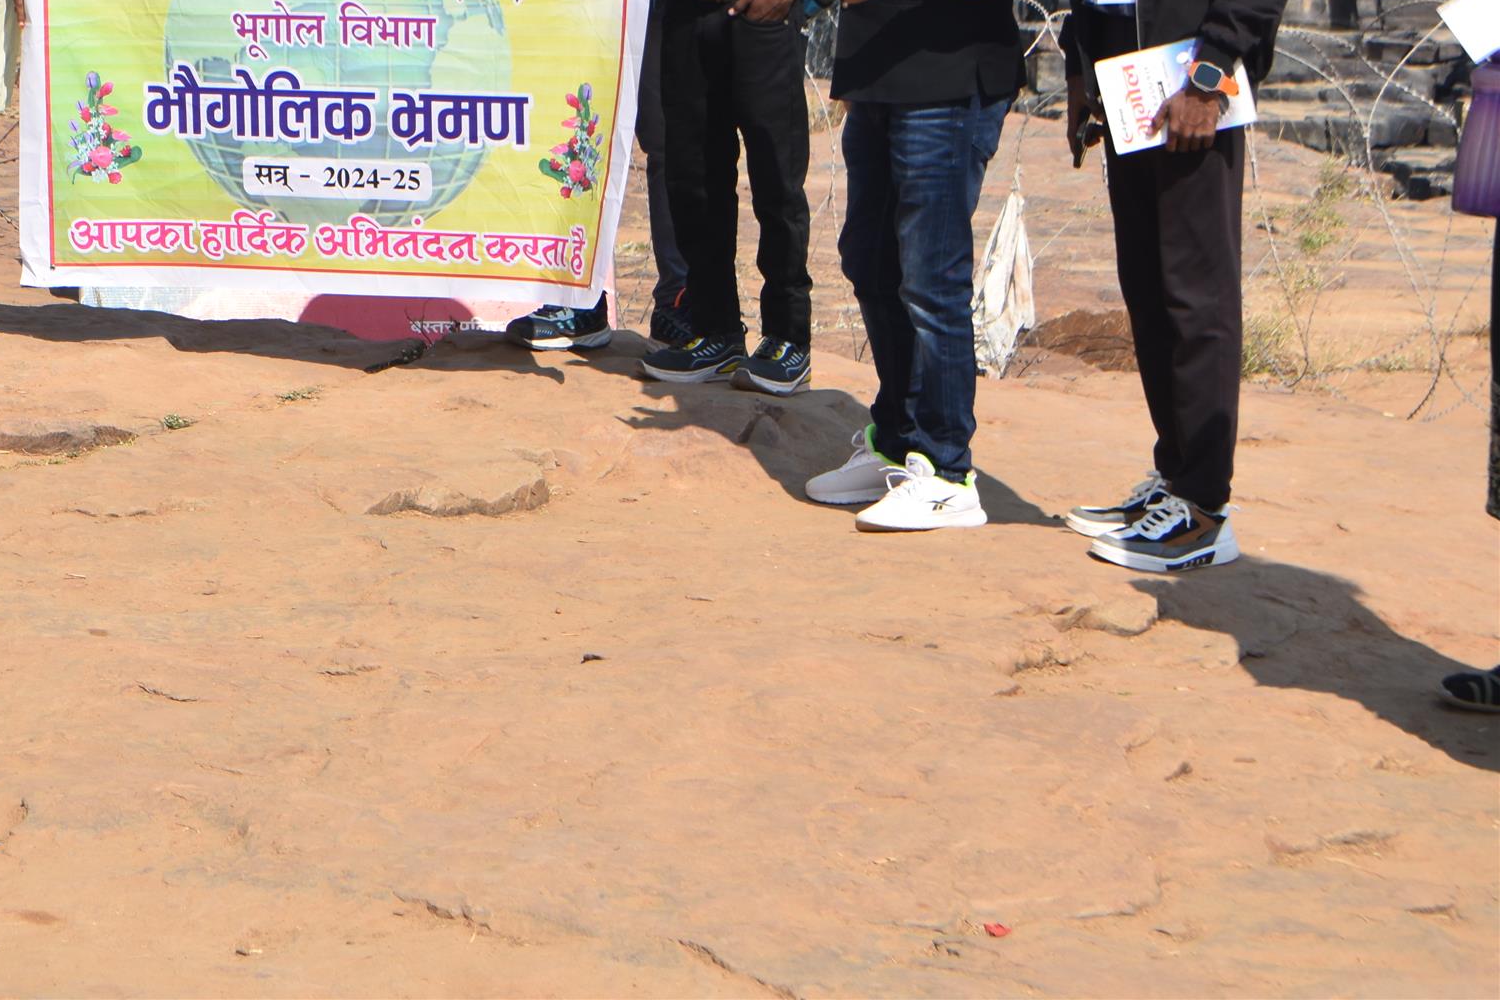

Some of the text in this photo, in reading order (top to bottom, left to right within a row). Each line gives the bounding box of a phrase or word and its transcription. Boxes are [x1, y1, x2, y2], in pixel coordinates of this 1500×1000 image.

[232, 1, 437, 59] भूगोल विभाग
[146, 64, 529, 147] भौगोलिक भ्रमण
[322, 166, 421, 191] 2024-25
[70, 211, 587, 276] आपका हार्दिक अभिनंदन करता है
